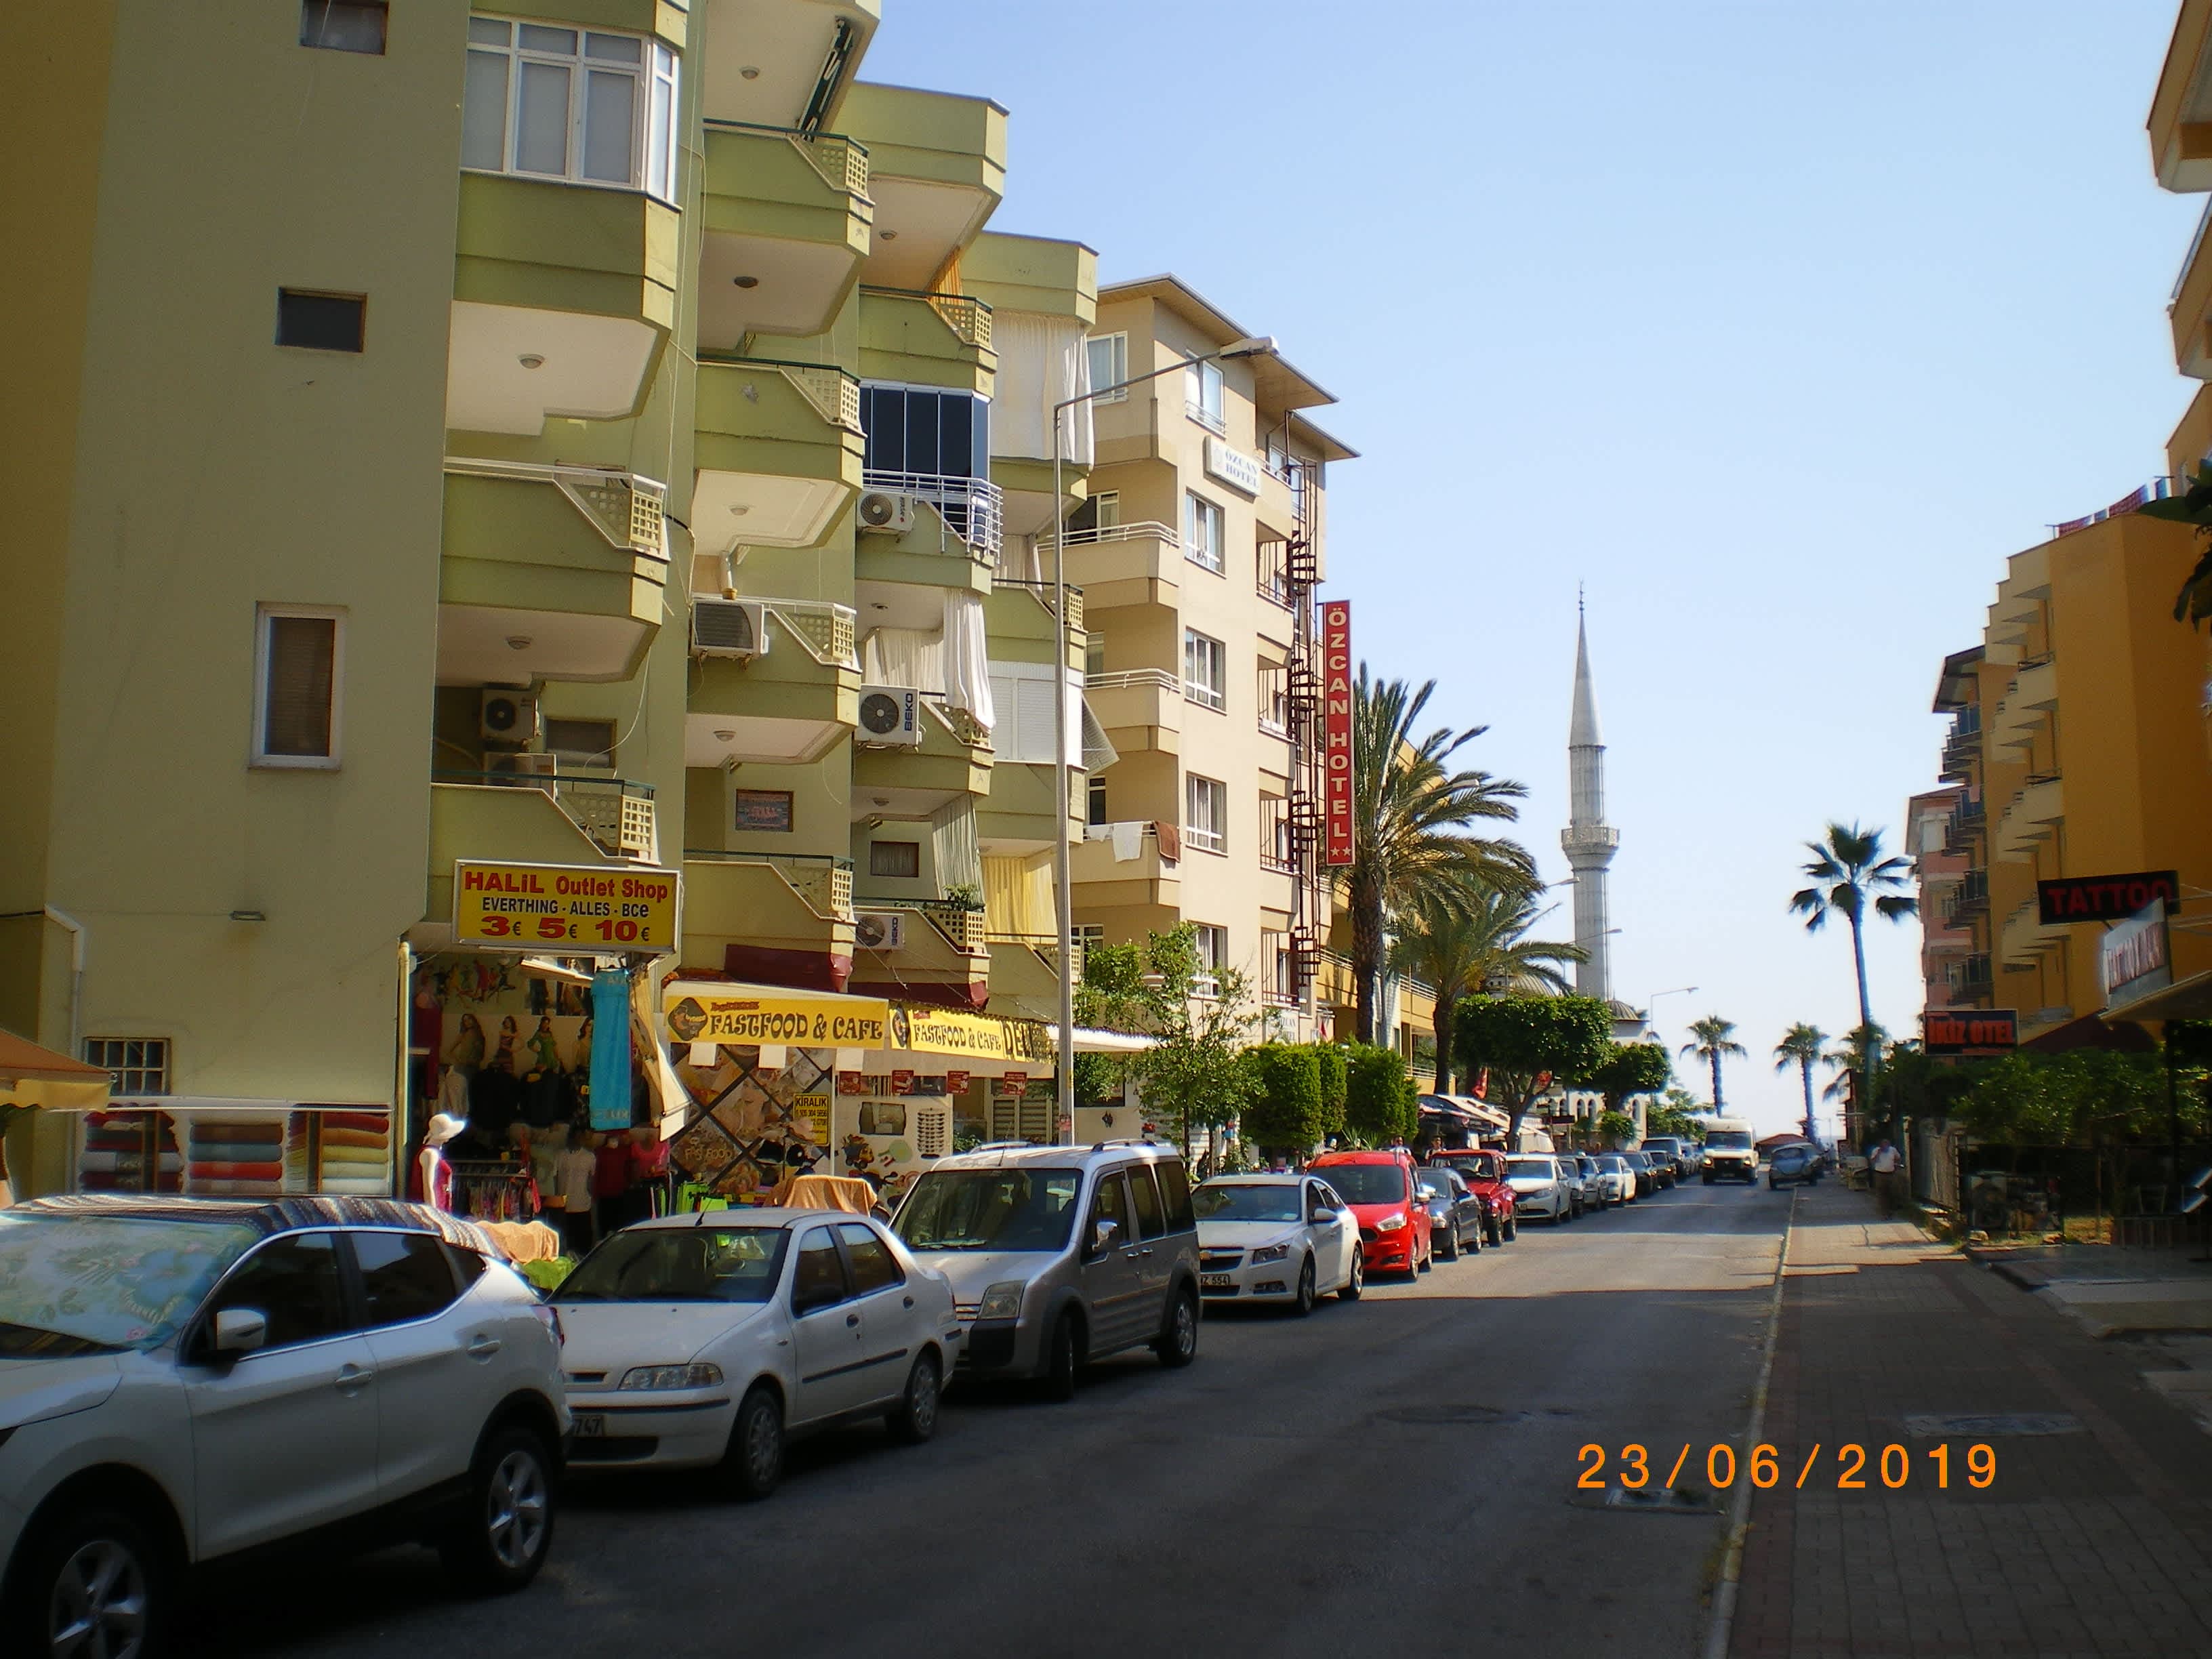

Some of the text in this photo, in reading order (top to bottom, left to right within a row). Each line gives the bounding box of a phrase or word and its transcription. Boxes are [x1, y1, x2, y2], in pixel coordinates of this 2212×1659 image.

[905, 693, 913, 731] BEKO
[1328, 607, 1349, 838] ÖZCAN HOTEL
[555, 875, 616, 897] Outlet
[621, 880, 668, 903] Shop
[482, 897, 558, 914] EVERTHING
[569, 900, 611, 916] ALLES
[710, 1012, 883, 1041] FASTFOOD & CAFE
[914, 1023, 1002, 1050] FASTFOOD & CAFE
[1969, 1019, 2014, 1044] OTEL
